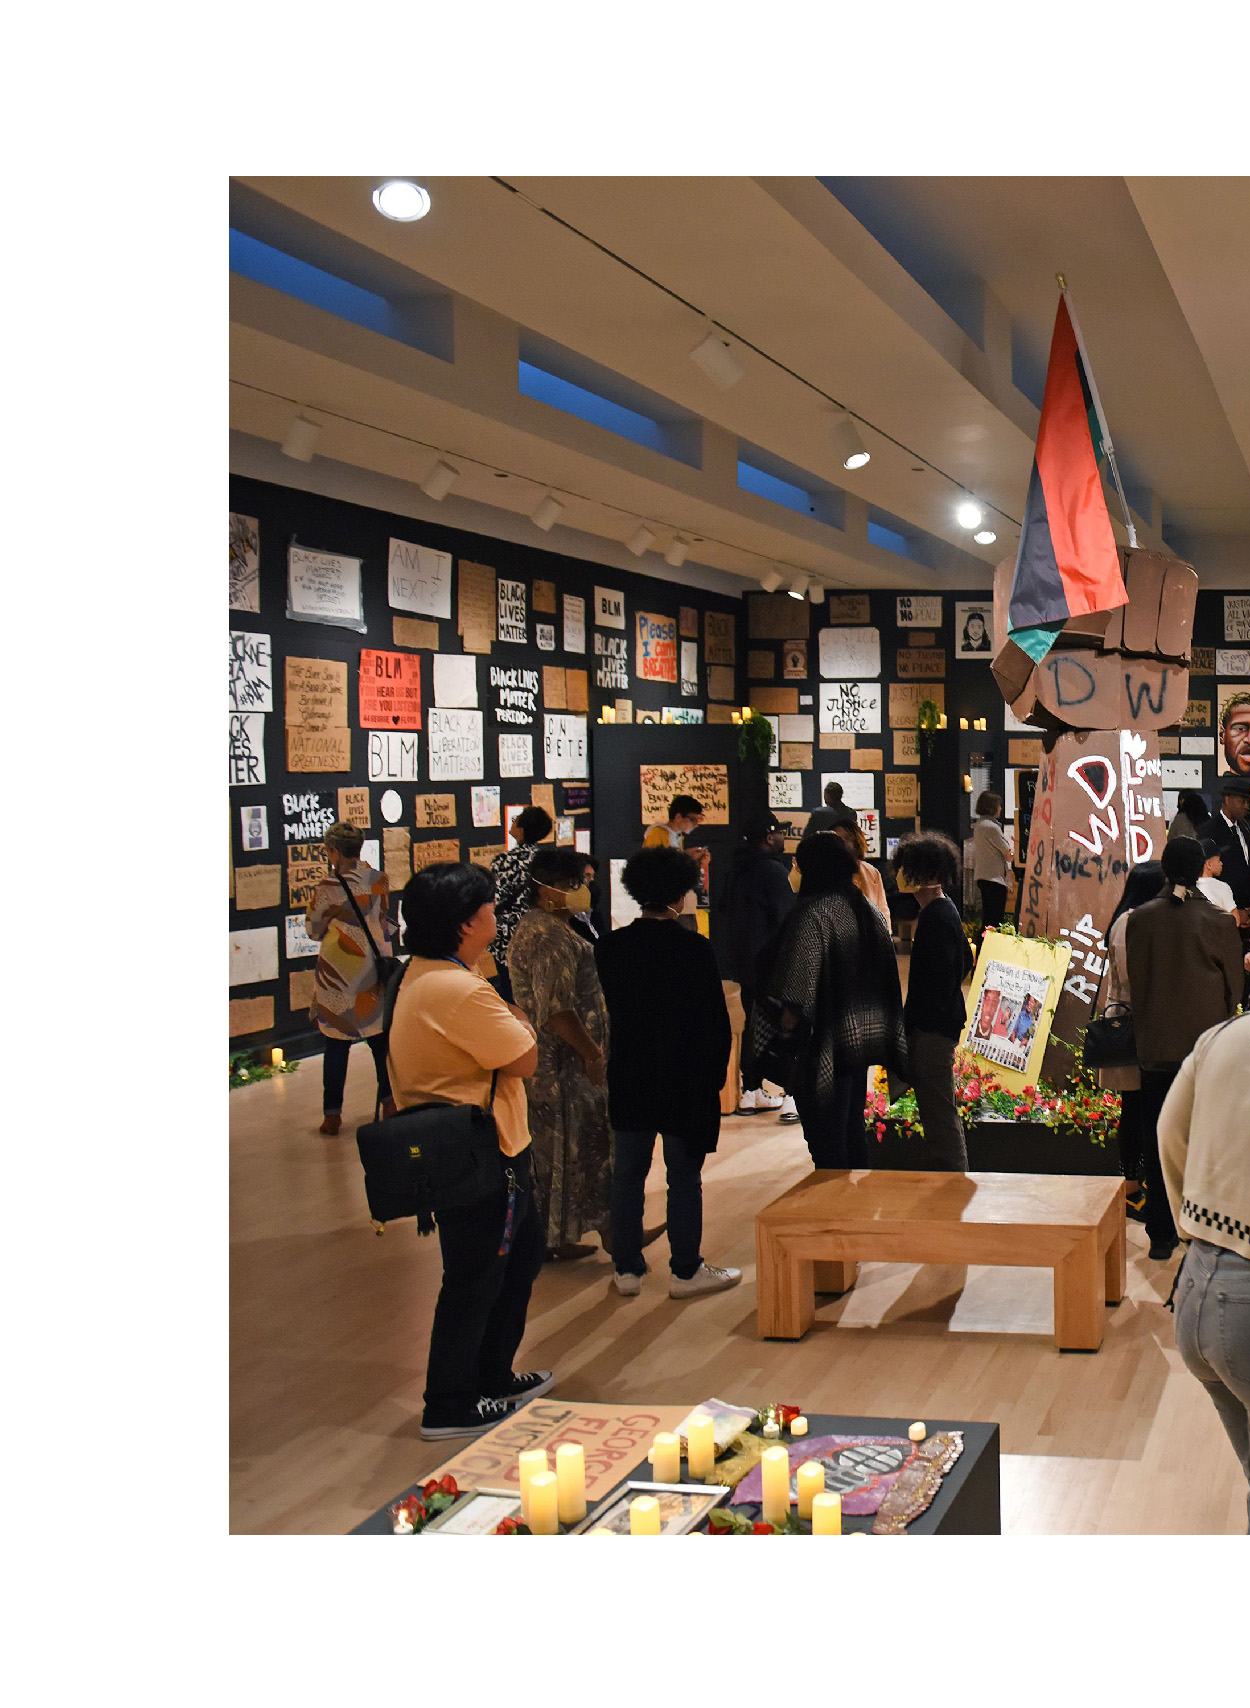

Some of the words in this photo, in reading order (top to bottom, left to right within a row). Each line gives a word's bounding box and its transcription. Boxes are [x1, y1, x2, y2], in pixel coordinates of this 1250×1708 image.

[393, 544, 420, 572] AM
[431, 555, 446, 581] I
[500, 583, 525, 606] BLACK
[500, 603, 525, 624] LIVES
[602, 598, 621, 616] BLM
[500, 623, 527, 640] MATTER
[639, 615, 674, 639] Please
[595, 632, 627, 659] BLACK
[643, 642, 650, 657] I
[376, 655, 402, 679] BLM
[602, 657, 626, 673] LIVES
[643, 657, 676, 681] BREATHE
[490, 666, 518, 687] BLACK
[518, 668, 538, 695] LIVES
[1048, 657, 1095, 707] D
[1125, 668, 1168, 719] W
[376, 686, 394, 697] HEAR
[500, 688, 537, 711] MATTER
[840, 683, 859, 699] NO
[827, 696, 877, 711] Justice
[842, 705, 860, 718] NO
[431, 713, 460, 734] BLACK
[501, 736, 528, 749] BLACK
[371, 734, 415, 778] BLM
[502, 750, 528, 762] LIVES
[502, 763, 531, 775] MATTER
[345, 793, 365, 804] BLACK
[887, 786, 912, 797] FLOYD
[302, 807, 335, 825] LIVES
[348, 806, 365, 816] LIVES
[295, 866, 323, 882] LIVES
[443, 1404, 573, 1486] JUSTICE
